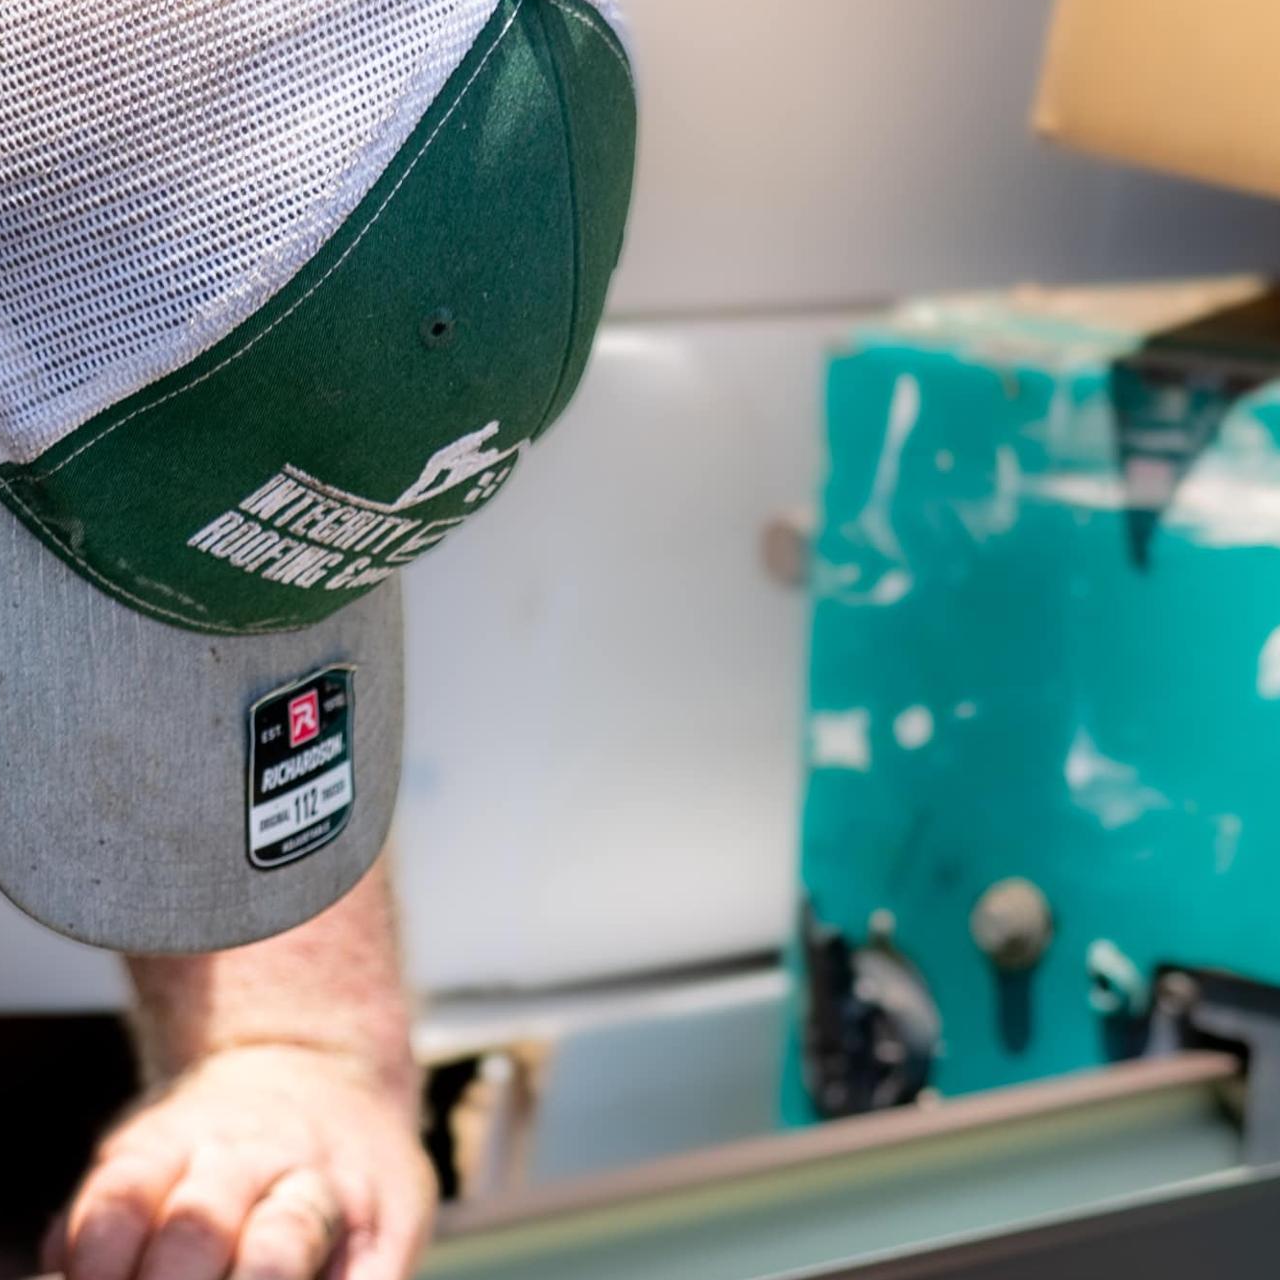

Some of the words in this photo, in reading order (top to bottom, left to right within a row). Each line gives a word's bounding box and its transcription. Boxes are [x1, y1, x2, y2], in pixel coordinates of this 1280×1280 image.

[187, 510, 345, 589] ROOFING
[238, 473, 422, 555] INTEGRITY
[261, 731, 343, 794] RICHARDSON
[294, 786, 318, 825] 112
